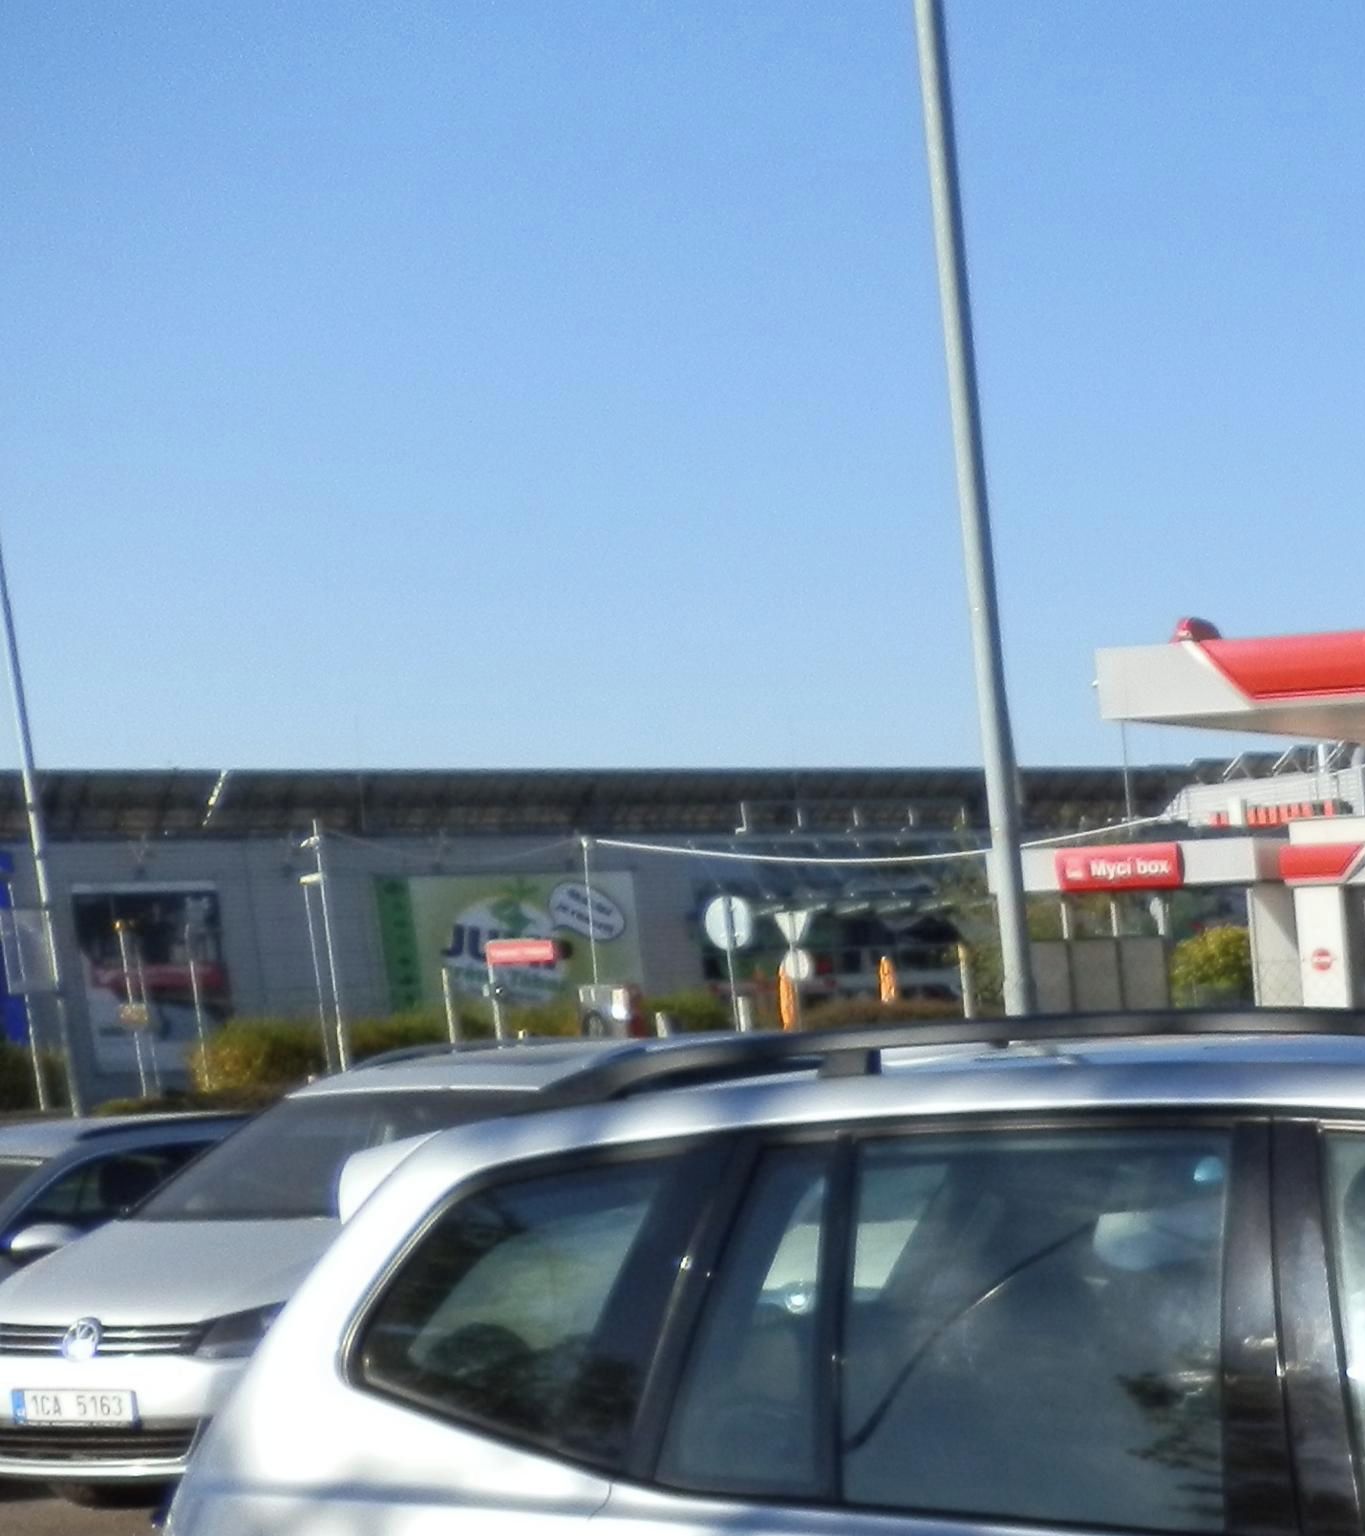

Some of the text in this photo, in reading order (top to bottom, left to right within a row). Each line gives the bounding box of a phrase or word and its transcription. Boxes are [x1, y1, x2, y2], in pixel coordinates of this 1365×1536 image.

[1090, 856, 1169, 881] Mycí box
[31, 1395, 123, 1417] 1CA 5163
